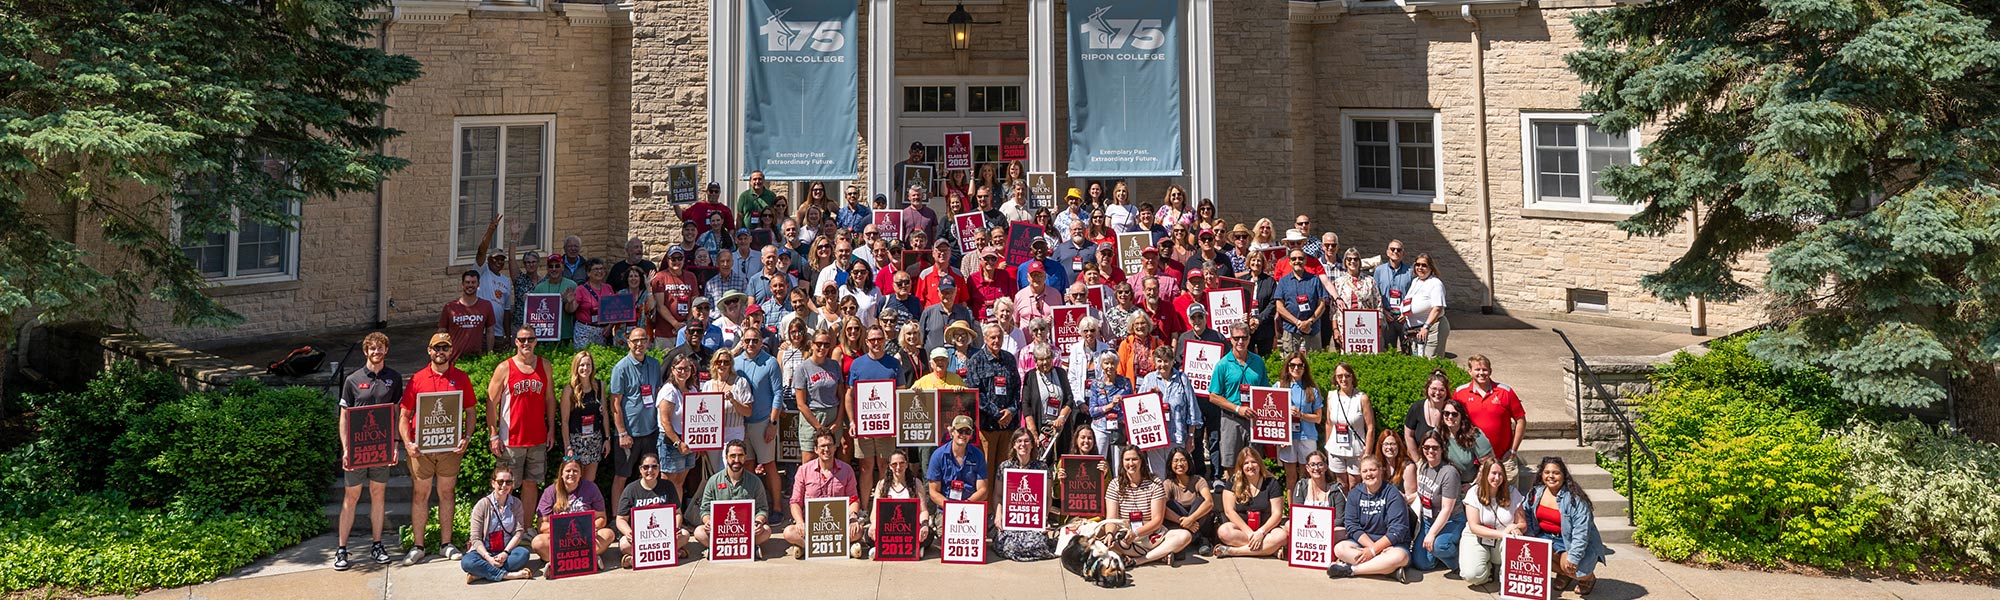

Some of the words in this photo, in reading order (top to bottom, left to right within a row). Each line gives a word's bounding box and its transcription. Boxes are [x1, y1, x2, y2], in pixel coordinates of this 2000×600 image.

[760, 17, 845, 52] 175
[1081, 15, 1165, 50] 175
[674, 193, 694, 201] 1995
[1126, 265, 1144, 274] 197
[1215, 307, 1237, 316] RIPON
[453, 315, 484, 323] RIPON
[1216, 325, 1229, 334] 19
[1059, 343, 1070, 353] 19
[1350, 345, 1373, 353] 1981
[1189, 360, 1213, 370] RIPON
[1187, 372, 1206, 380] CLASS
[514, 379, 543, 396] RIPON
[862, 401, 887, 410] RIPON
[690, 414, 716, 423] RIPON
[903, 411, 929, 420] RIPON
[1131, 412, 1156, 424] RIPON
[1257, 409, 1283, 418] RIPON
[424, 415, 453, 425] RIPON
[862, 420, 890, 431] 1969
[1132, 426, 1153, 435] CLASS
[354, 429, 387, 442] RIPON
[422, 427, 445, 435] CLASS
[903, 430, 932, 440] 1967
[1257, 427, 1286, 438] 1986
[422, 434, 455, 447] 2023
[688, 434, 716, 444] 2001
[1135, 431, 1162, 445] 1961
[353, 450, 387, 464] 2024
[1068, 480, 1096, 490] RIPON
[636, 494, 667, 507] RIPON
[1010, 492, 1037, 502] RIPON
[1009, 512, 1040, 525] 2014
[718, 524, 745, 534] RIPON
[813, 522, 840, 532] RIPON
[884, 523, 911, 532] RIPON
[950, 524, 977, 533] RIPON
[640, 529, 668, 540] RIPON
[1297, 528, 1324, 539] RIPON
[560, 536, 587, 548] RIPON
[639, 543, 661, 551] CLASS
[1295, 542, 1317, 550] CLASS
[716, 544, 748, 557] 2010
[812, 541, 842, 554] 2011
[882, 543, 913, 555] 2012
[948, 546, 979, 557] 2013
[557, 551, 579, 559] CLASS
[639, 550, 671, 563] 2009
[1295, 550, 1326, 563] 2021
[557, 558, 590, 572] 2008
[1510, 560, 1540, 572] RIPON
[1508, 573, 1532, 583] CLASS
[1508, 581, 1543, 597] 2022
